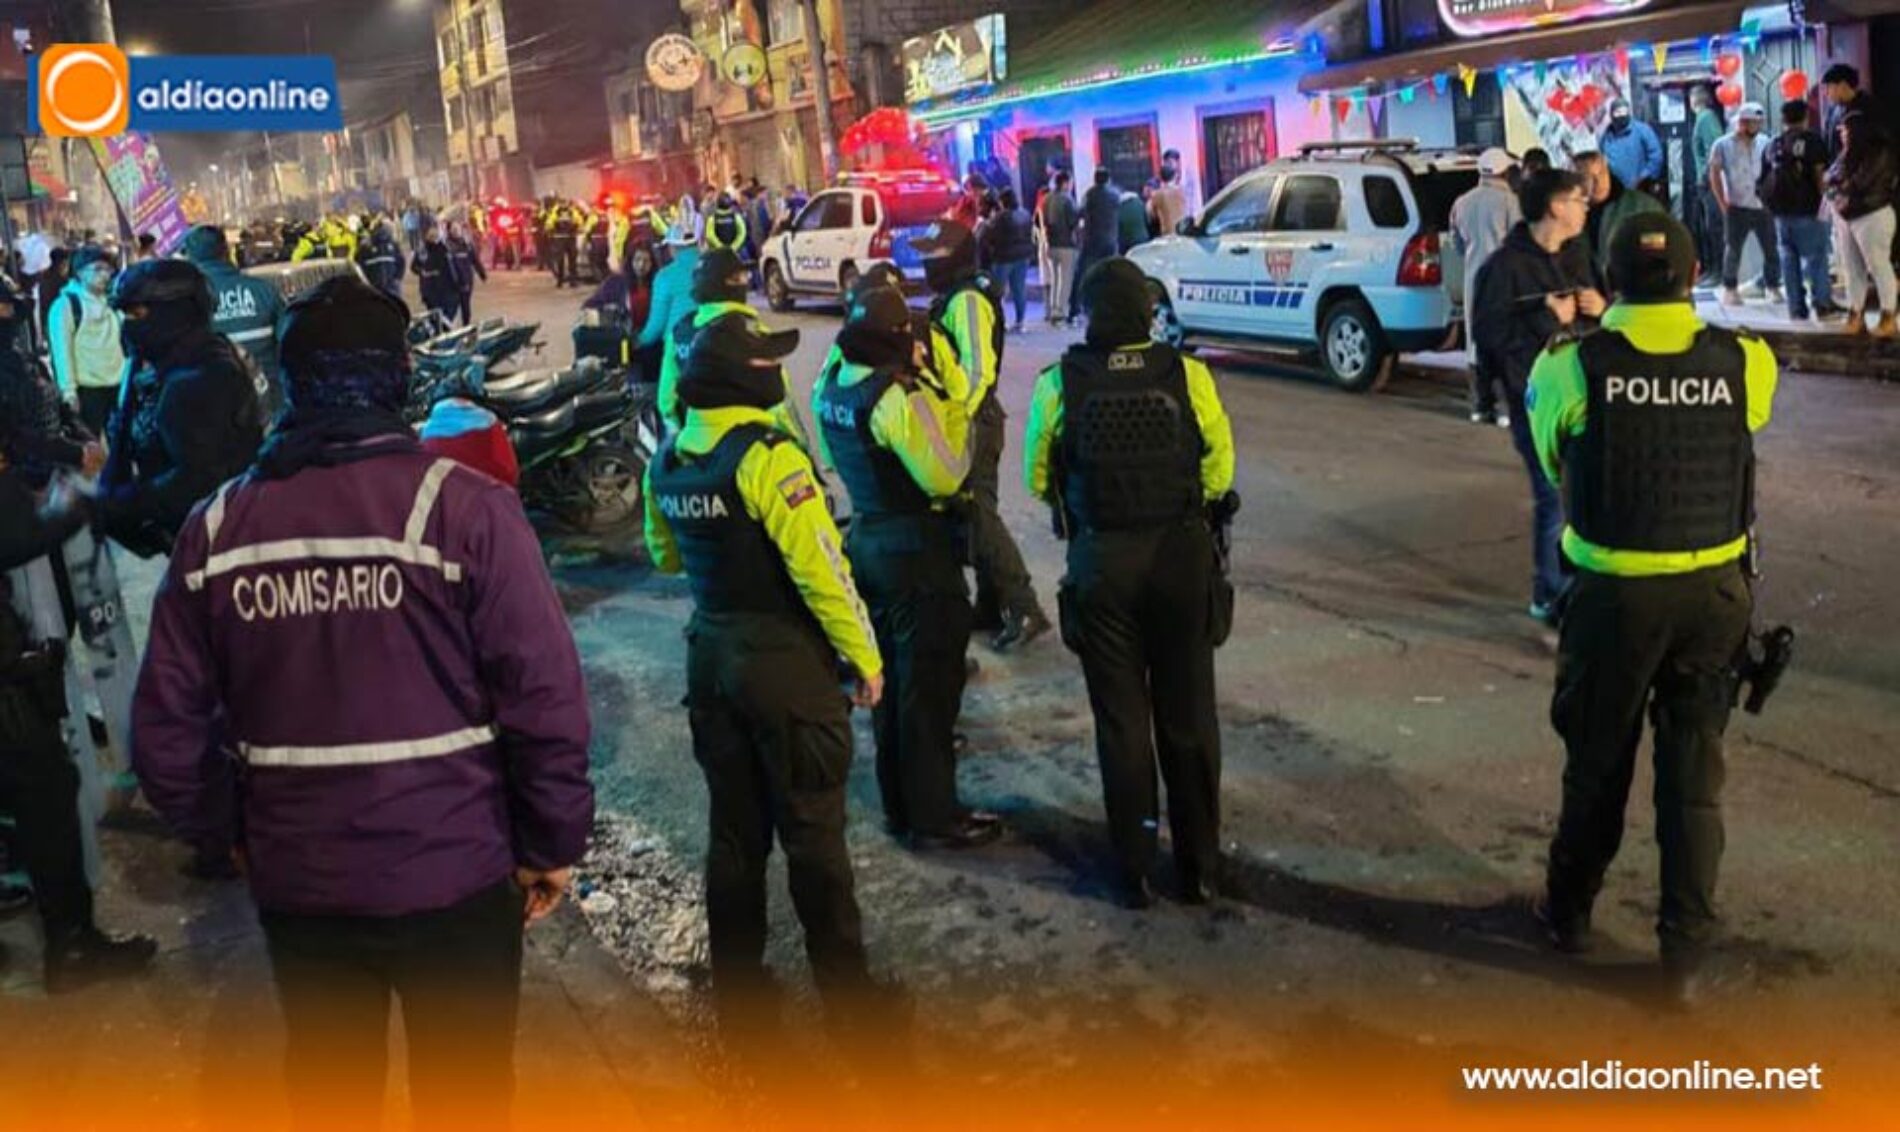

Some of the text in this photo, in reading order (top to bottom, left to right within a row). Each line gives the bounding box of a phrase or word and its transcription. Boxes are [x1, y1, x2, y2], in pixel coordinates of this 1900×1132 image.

[1182, 286, 1246, 304] POLICIA
[1605, 376, 1734, 406] POLICIA
[232, 563, 404, 622] COMISARIO
